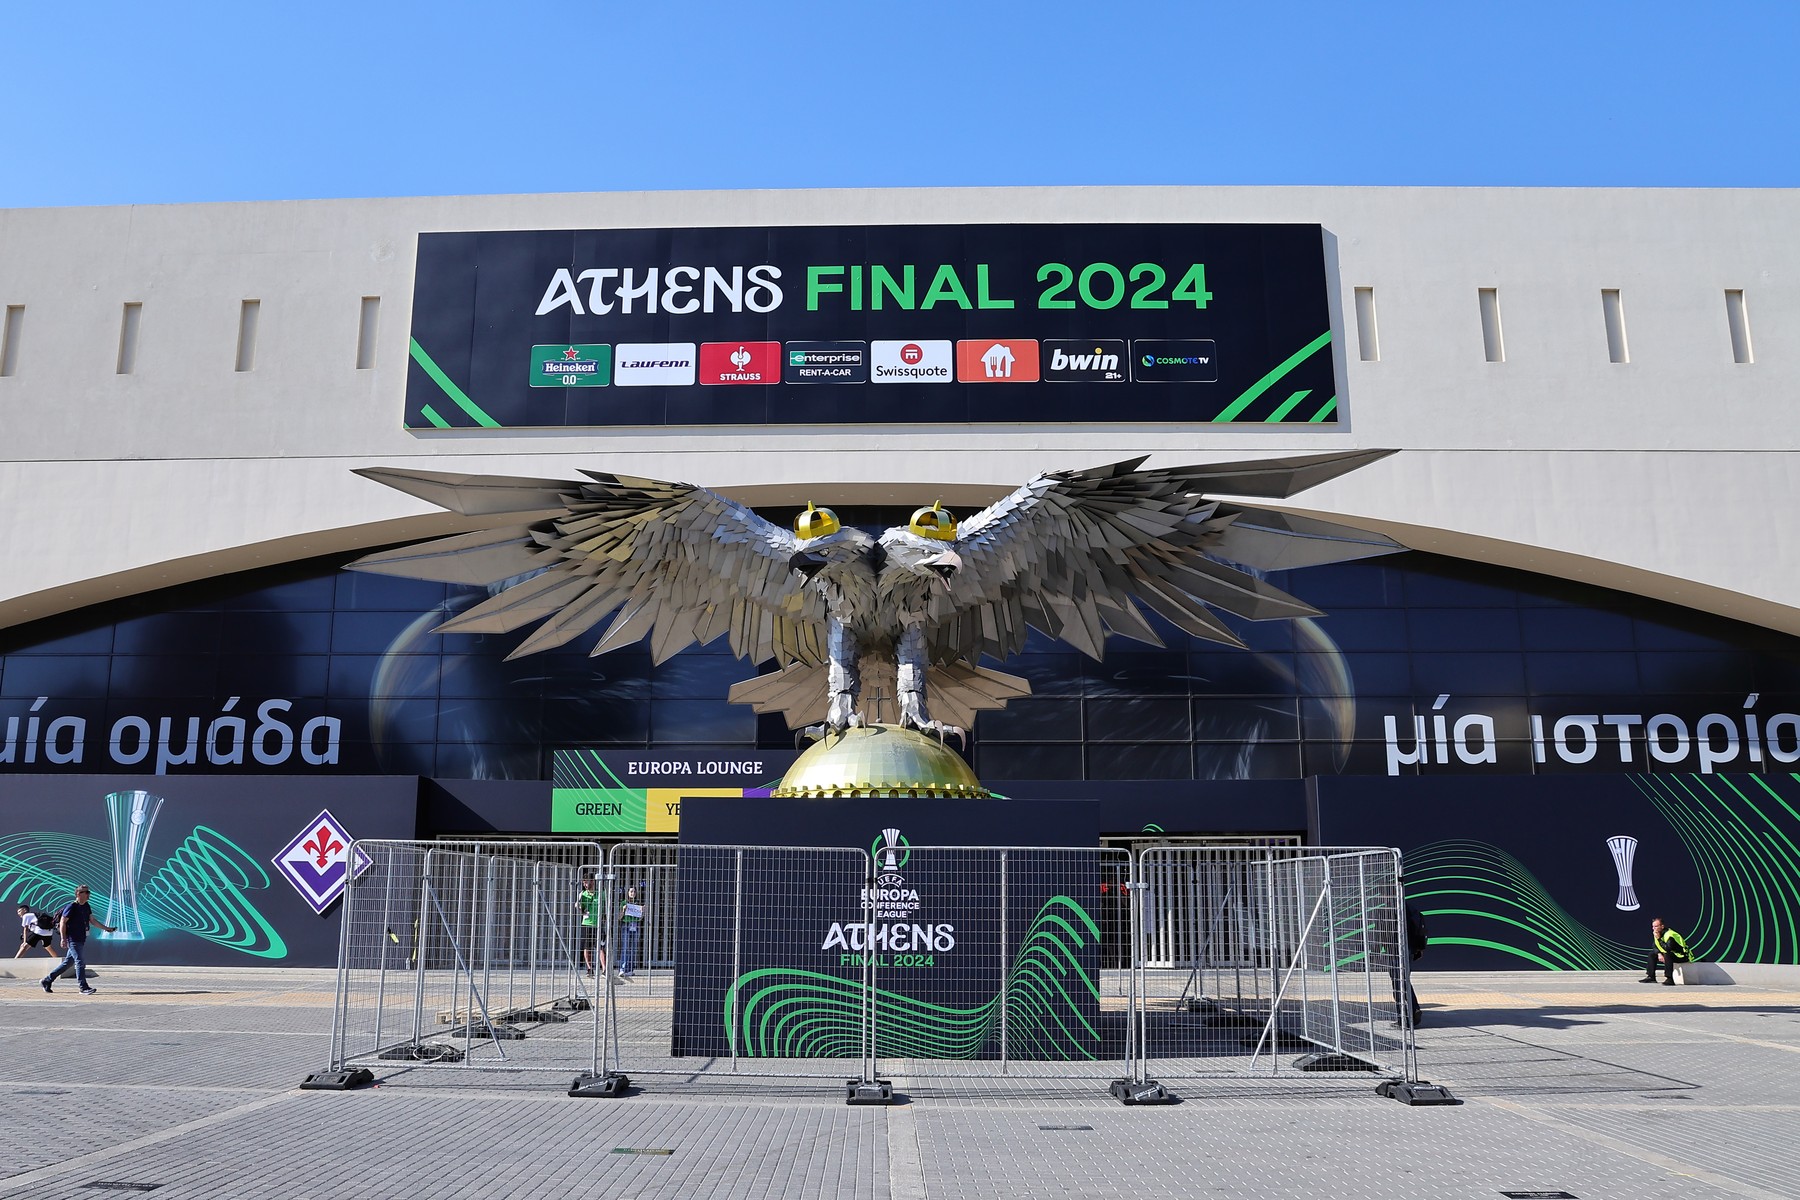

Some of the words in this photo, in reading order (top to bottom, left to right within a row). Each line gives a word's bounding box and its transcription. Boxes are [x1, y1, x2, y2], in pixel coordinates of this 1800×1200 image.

[534, 264, 784, 316] ATHENS
[805, 263, 1015, 312] FINAL
[1036, 262, 1214, 310] 2024
[794, 353, 860, 363] enterprise
[1050, 347, 1119, 371] bwin
[545, 362, 595, 372] Heineken
[799, 368, 852, 377] RENT-A-CAR
[876, 365, 948, 379] Swissquote
[719, 372, 761, 381] STRAUSS
[109, 696, 342, 775] ομάδα
[1384, 694, 1497, 776] μία
[628, 761, 692, 775] EUROPA
[697, 761, 763, 775] LOUNGE
[575, 802, 622, 816] GREEN
[877, 876, 903, 886] UEFA
[861, 889, 920, 901] EUROPA
[873, 910, 907, 918] EAGUE
[821, 922, 955, 951] ATHENS
[840, 953, 889, 967] FINAL
[893, 954, 935, 967] 2024
